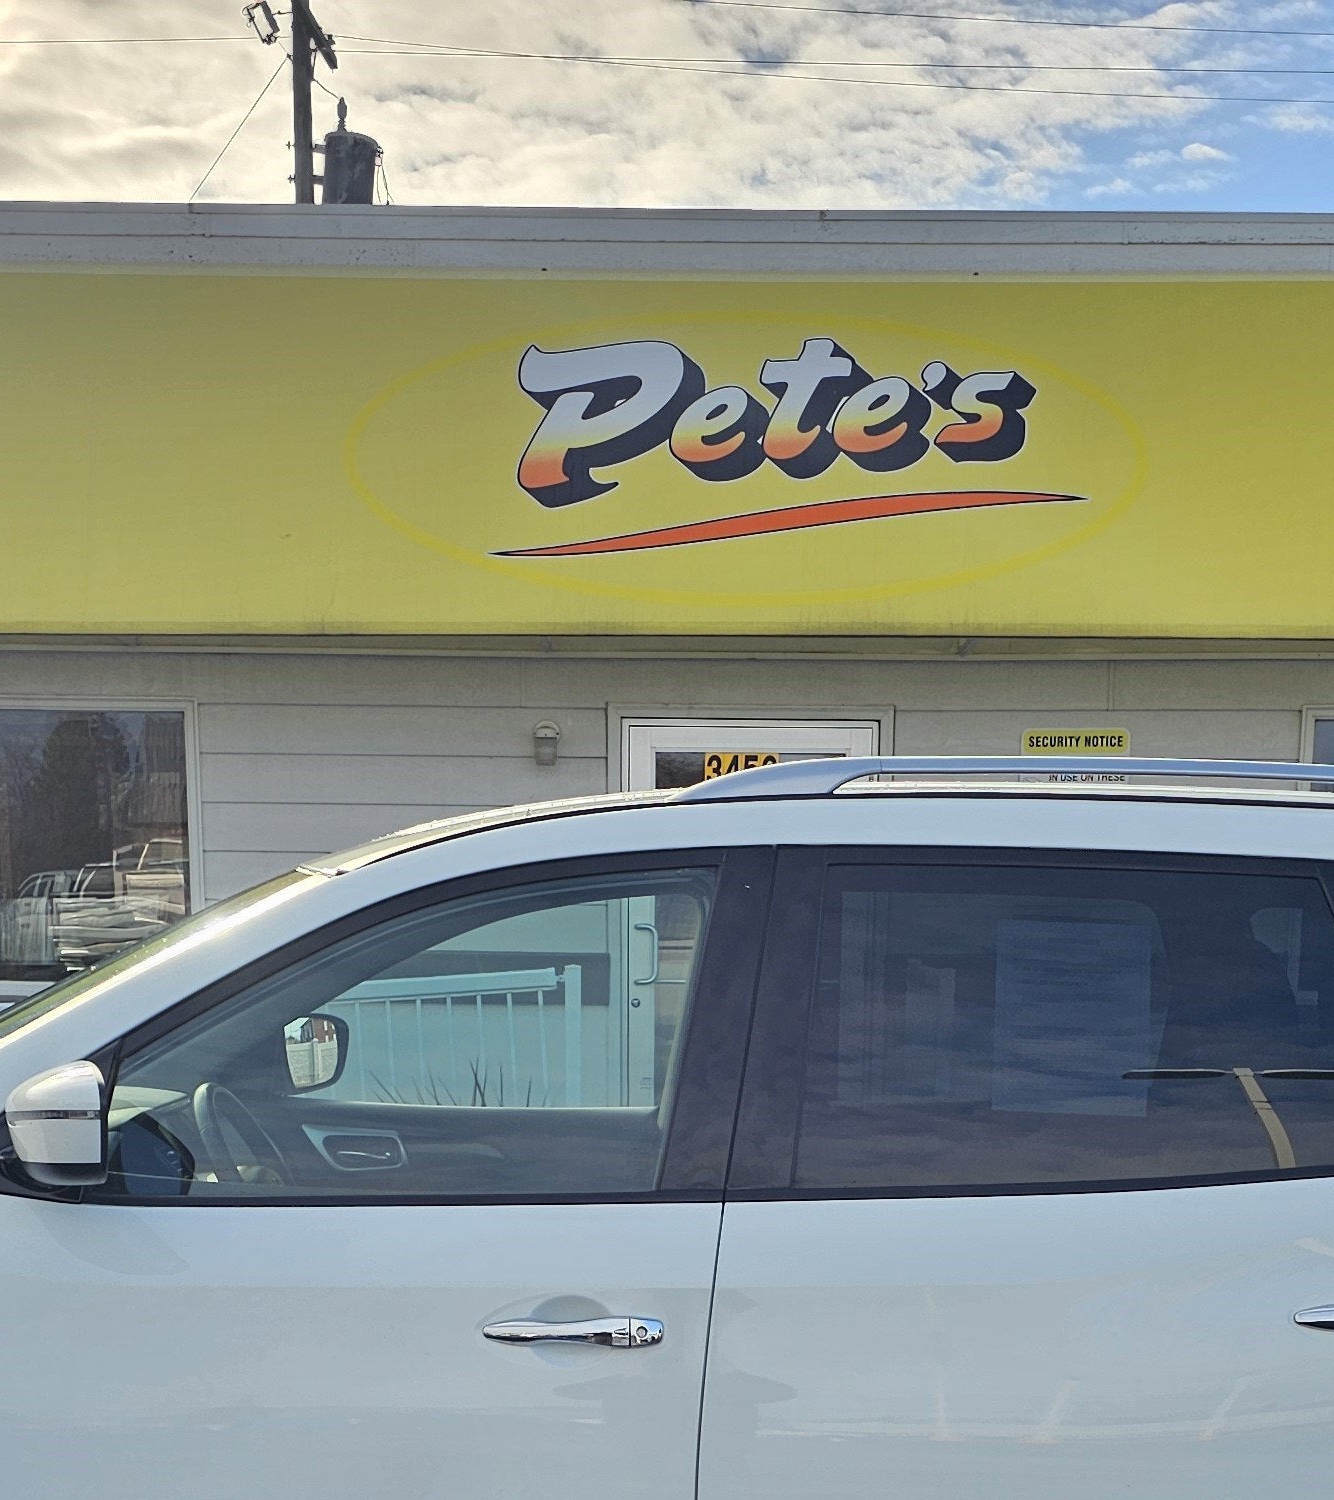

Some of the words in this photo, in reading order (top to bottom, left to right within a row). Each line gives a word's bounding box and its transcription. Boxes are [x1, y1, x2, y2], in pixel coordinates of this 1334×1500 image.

[517, 338, 1037, 508] Pete's
[1028, 735, 1081, 748] SECURITY
[1084, 735, 1124, 748] NOTICE
[1060, 773, 1078, 782] USE
[1097, 773, 1126, 782] THESE
